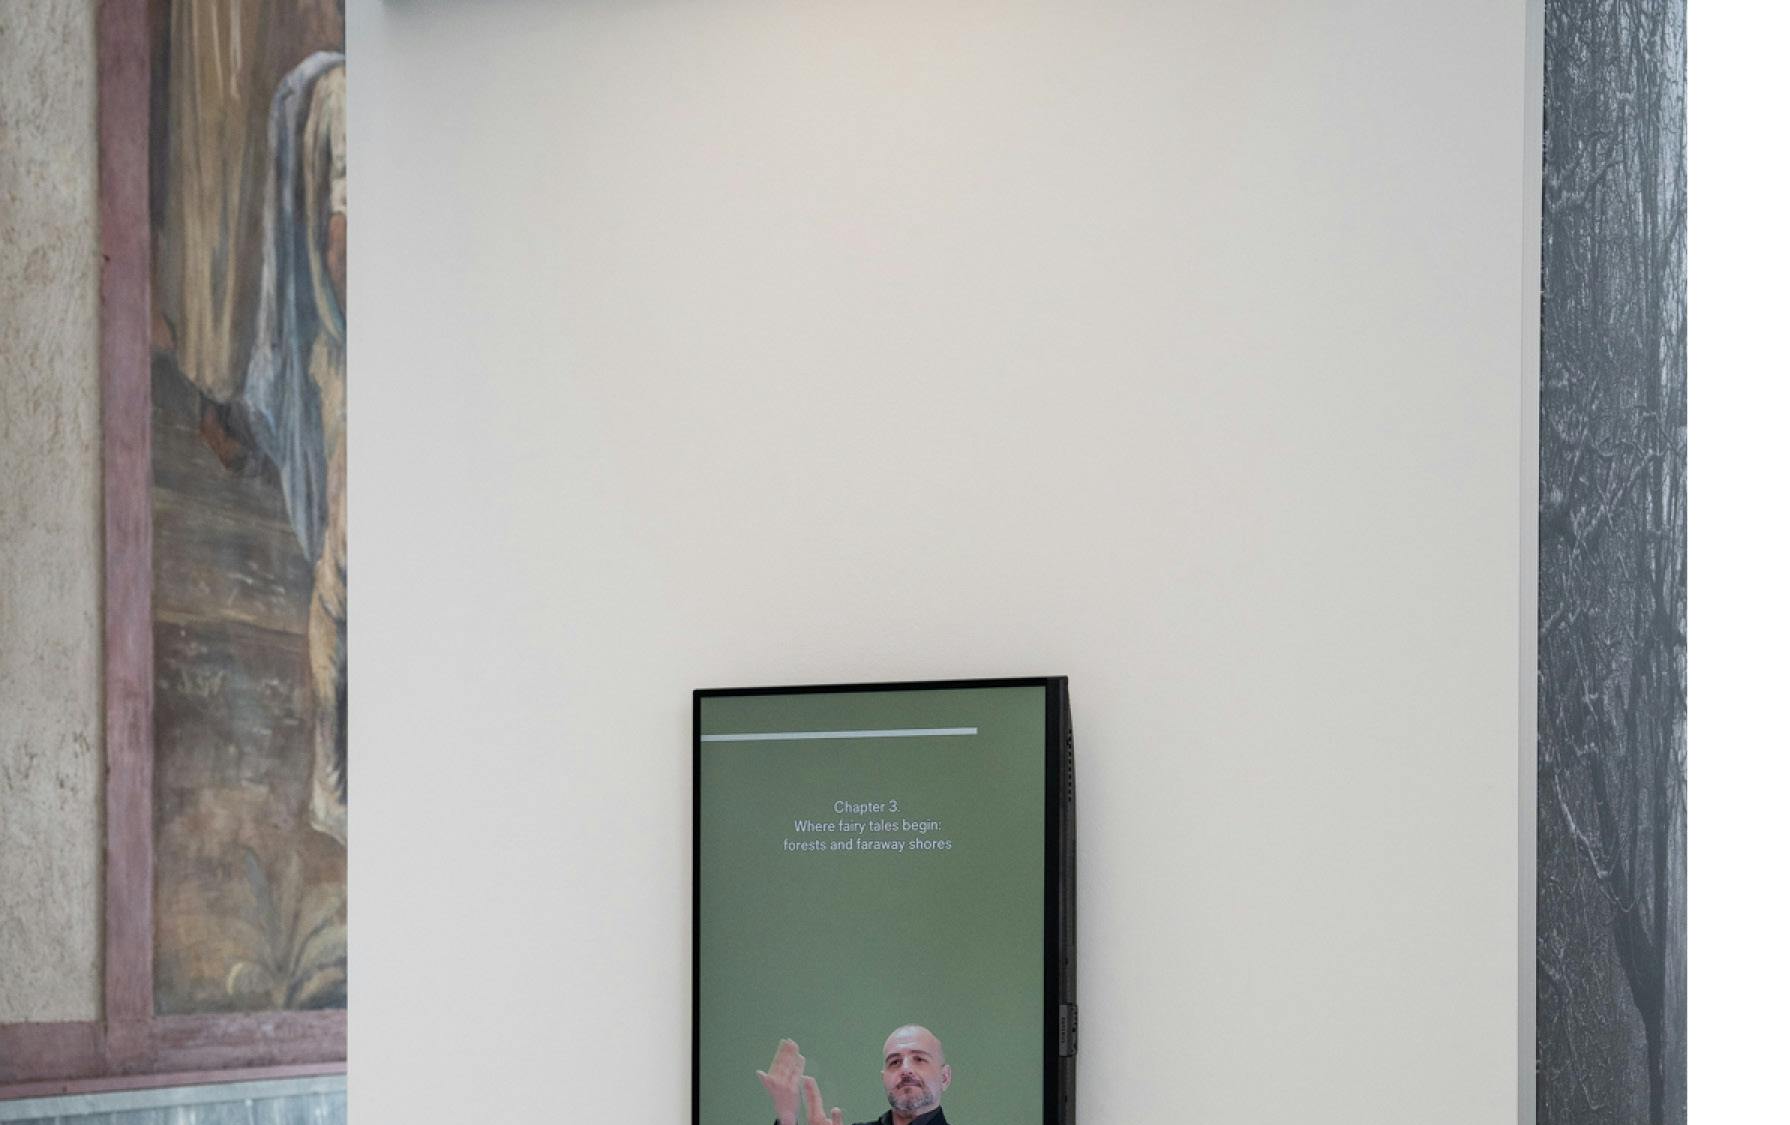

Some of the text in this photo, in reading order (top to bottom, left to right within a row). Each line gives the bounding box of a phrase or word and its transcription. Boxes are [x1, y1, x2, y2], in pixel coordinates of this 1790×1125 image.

[833, 800, 886, 816] Chapter
[794, 819, 942, 835] Where fairy tales begin:
[784, 837, 952, 853] forests and faraway shores
